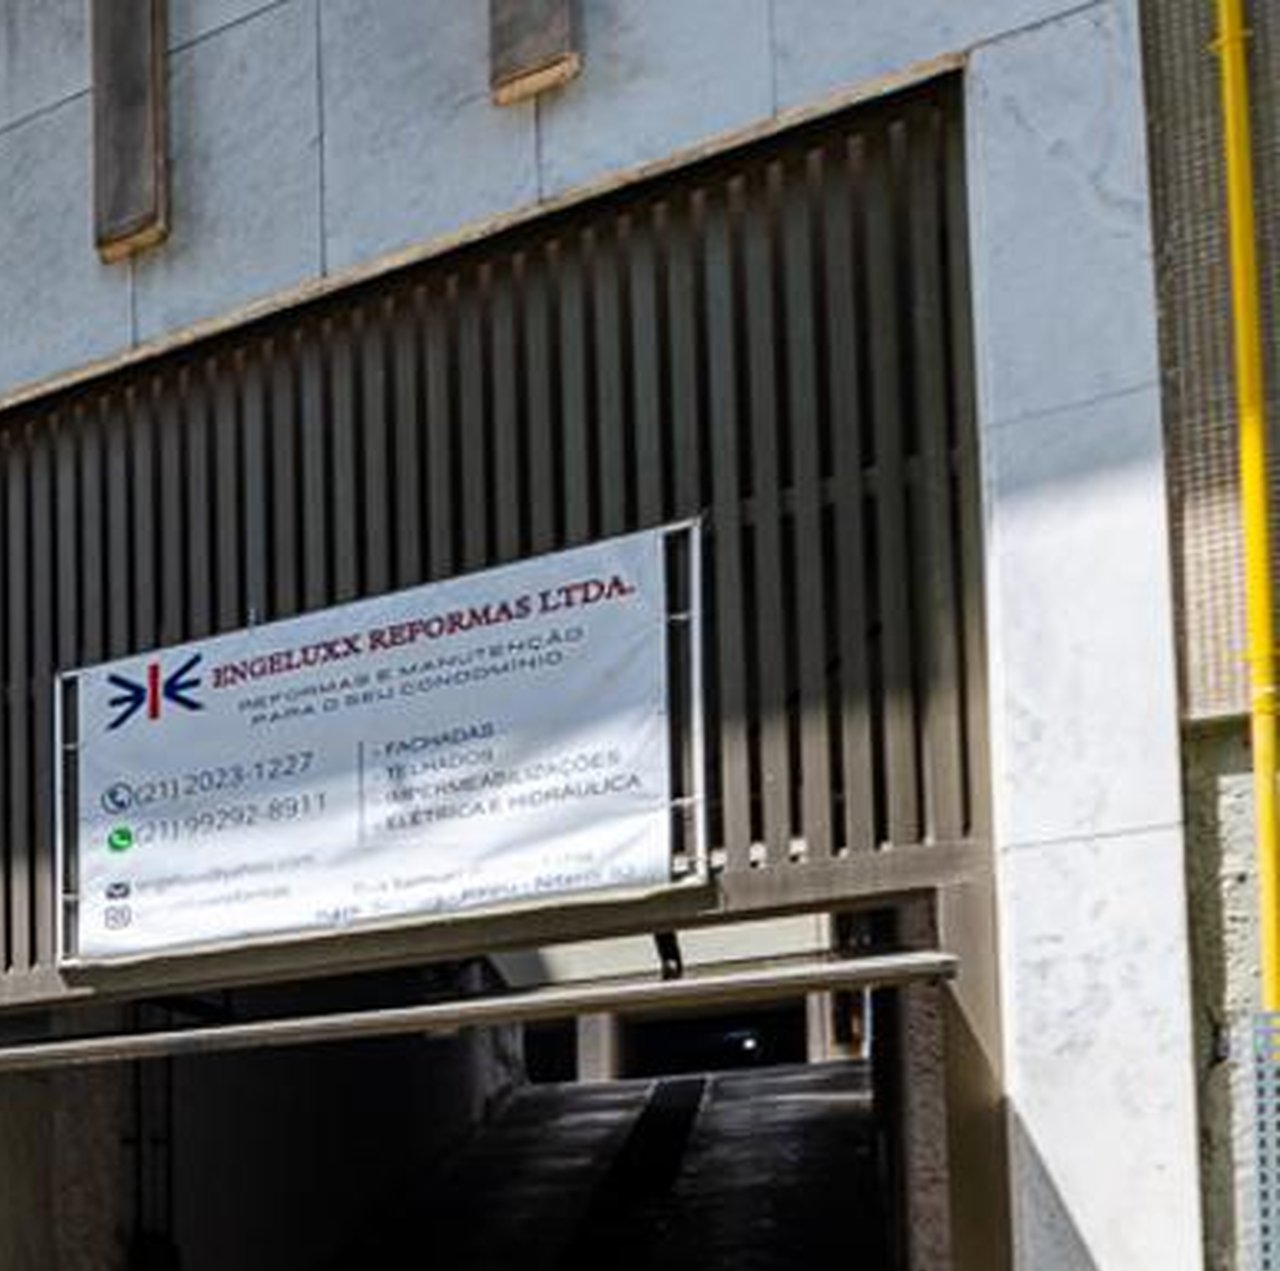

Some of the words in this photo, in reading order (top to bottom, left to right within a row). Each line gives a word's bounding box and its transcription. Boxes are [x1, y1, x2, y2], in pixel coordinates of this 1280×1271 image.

[212, 633, 362, 689] ENGELUXX
[367, 595, 532, 652] REFORMAS
[539, 575, 637, 615] LTDA.
